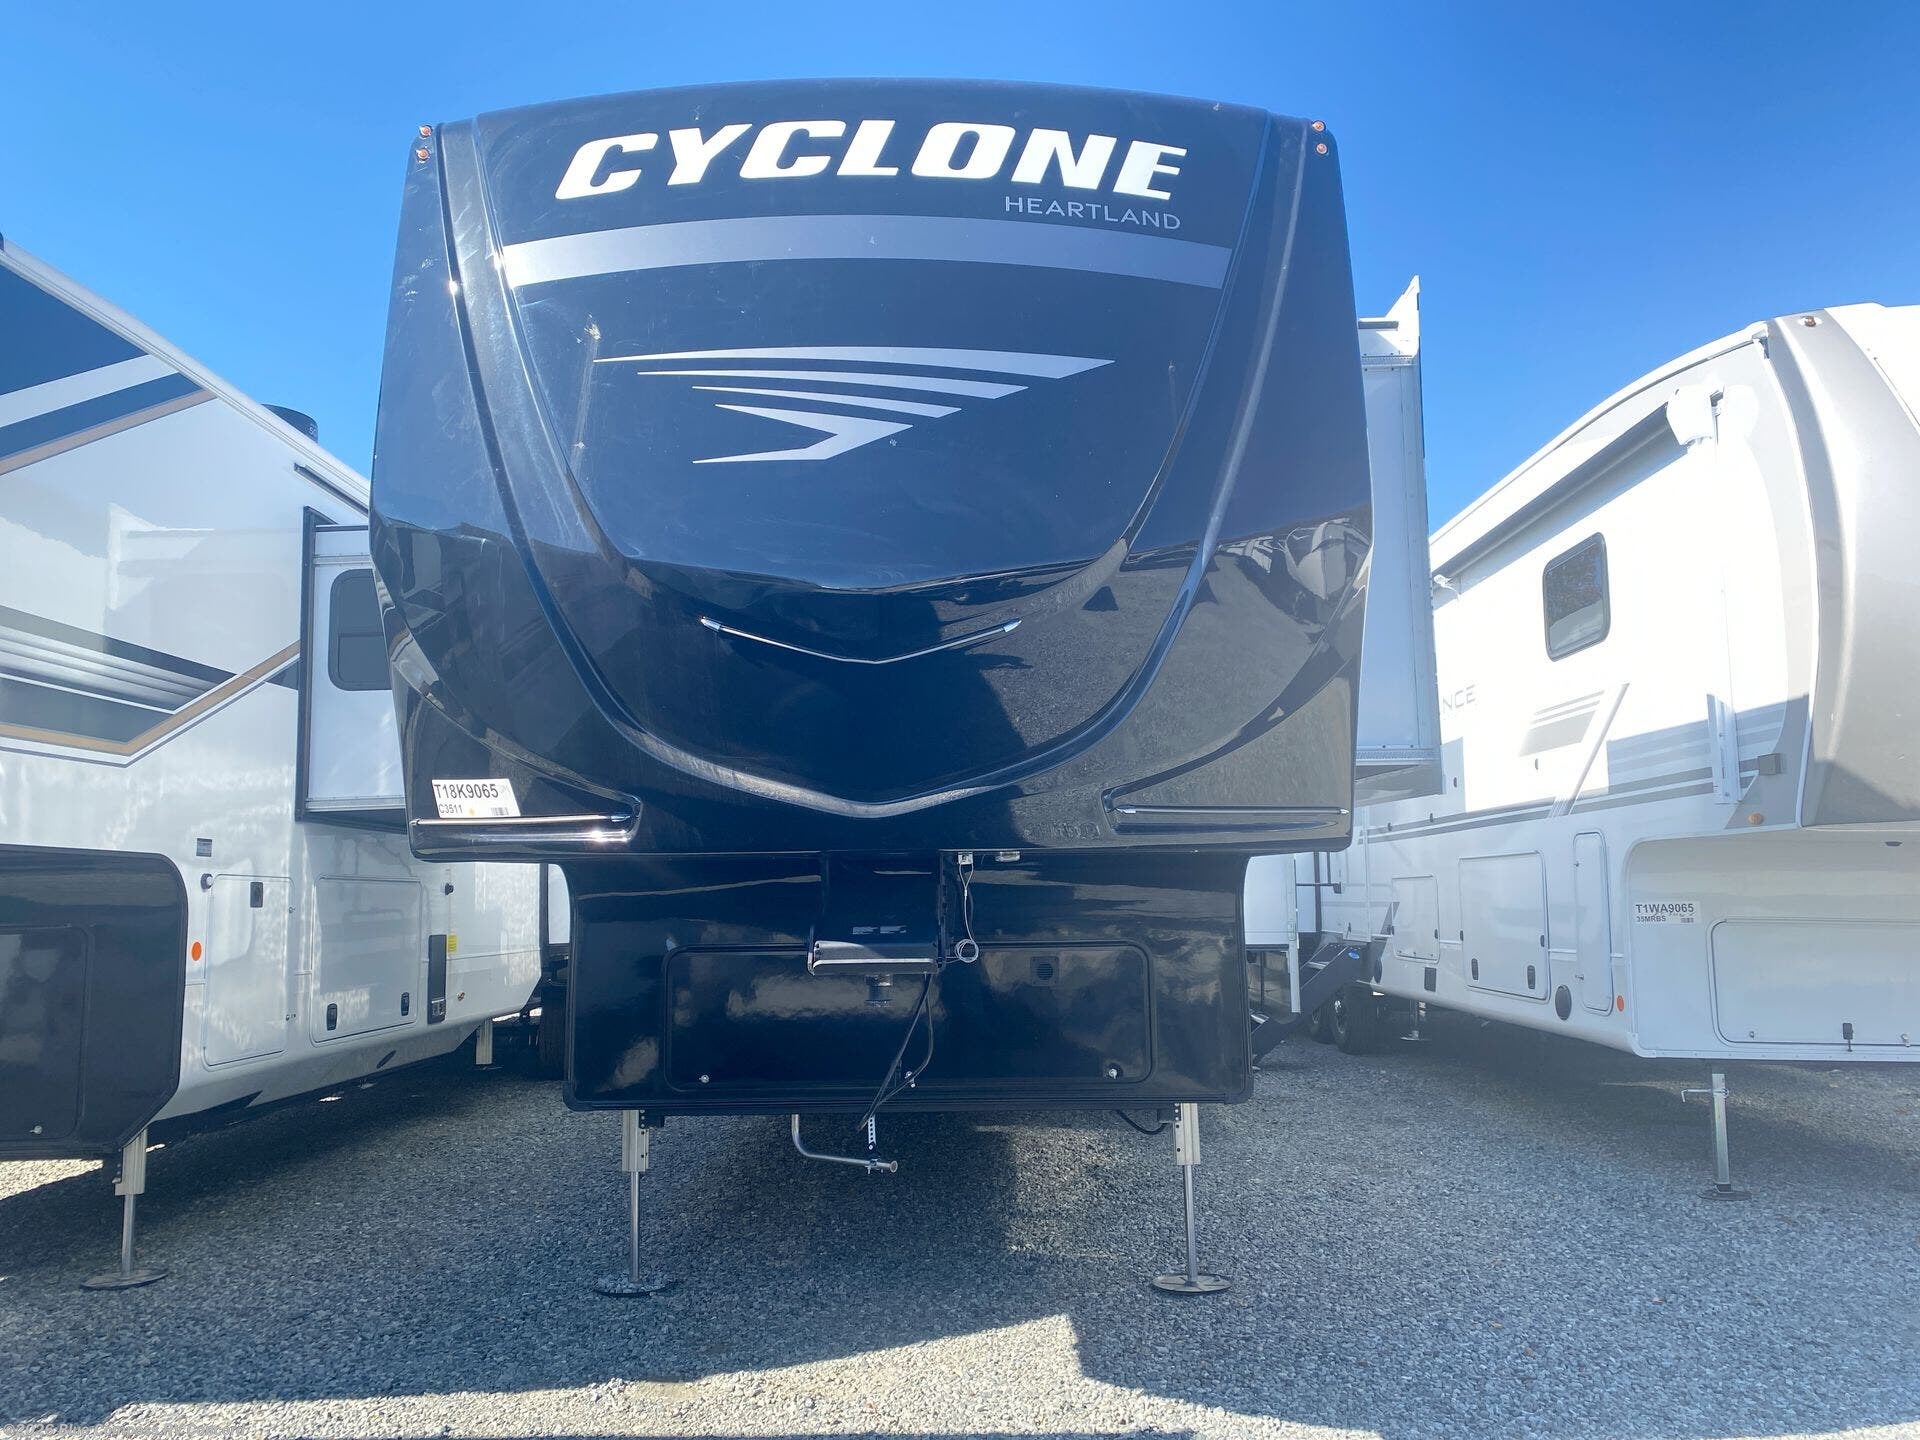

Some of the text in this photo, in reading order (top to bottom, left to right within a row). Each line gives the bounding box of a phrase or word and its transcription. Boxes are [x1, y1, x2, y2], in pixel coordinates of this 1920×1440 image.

[555, 119, 1188, 200] CYCLONE
[1005, 196, 1181, 230] HEARTLAND
[434, 784, 499, 799] T18K9065
[438, 803, 463, 814] C3511
[1635, 903, 1694, 913] T1WA9065
